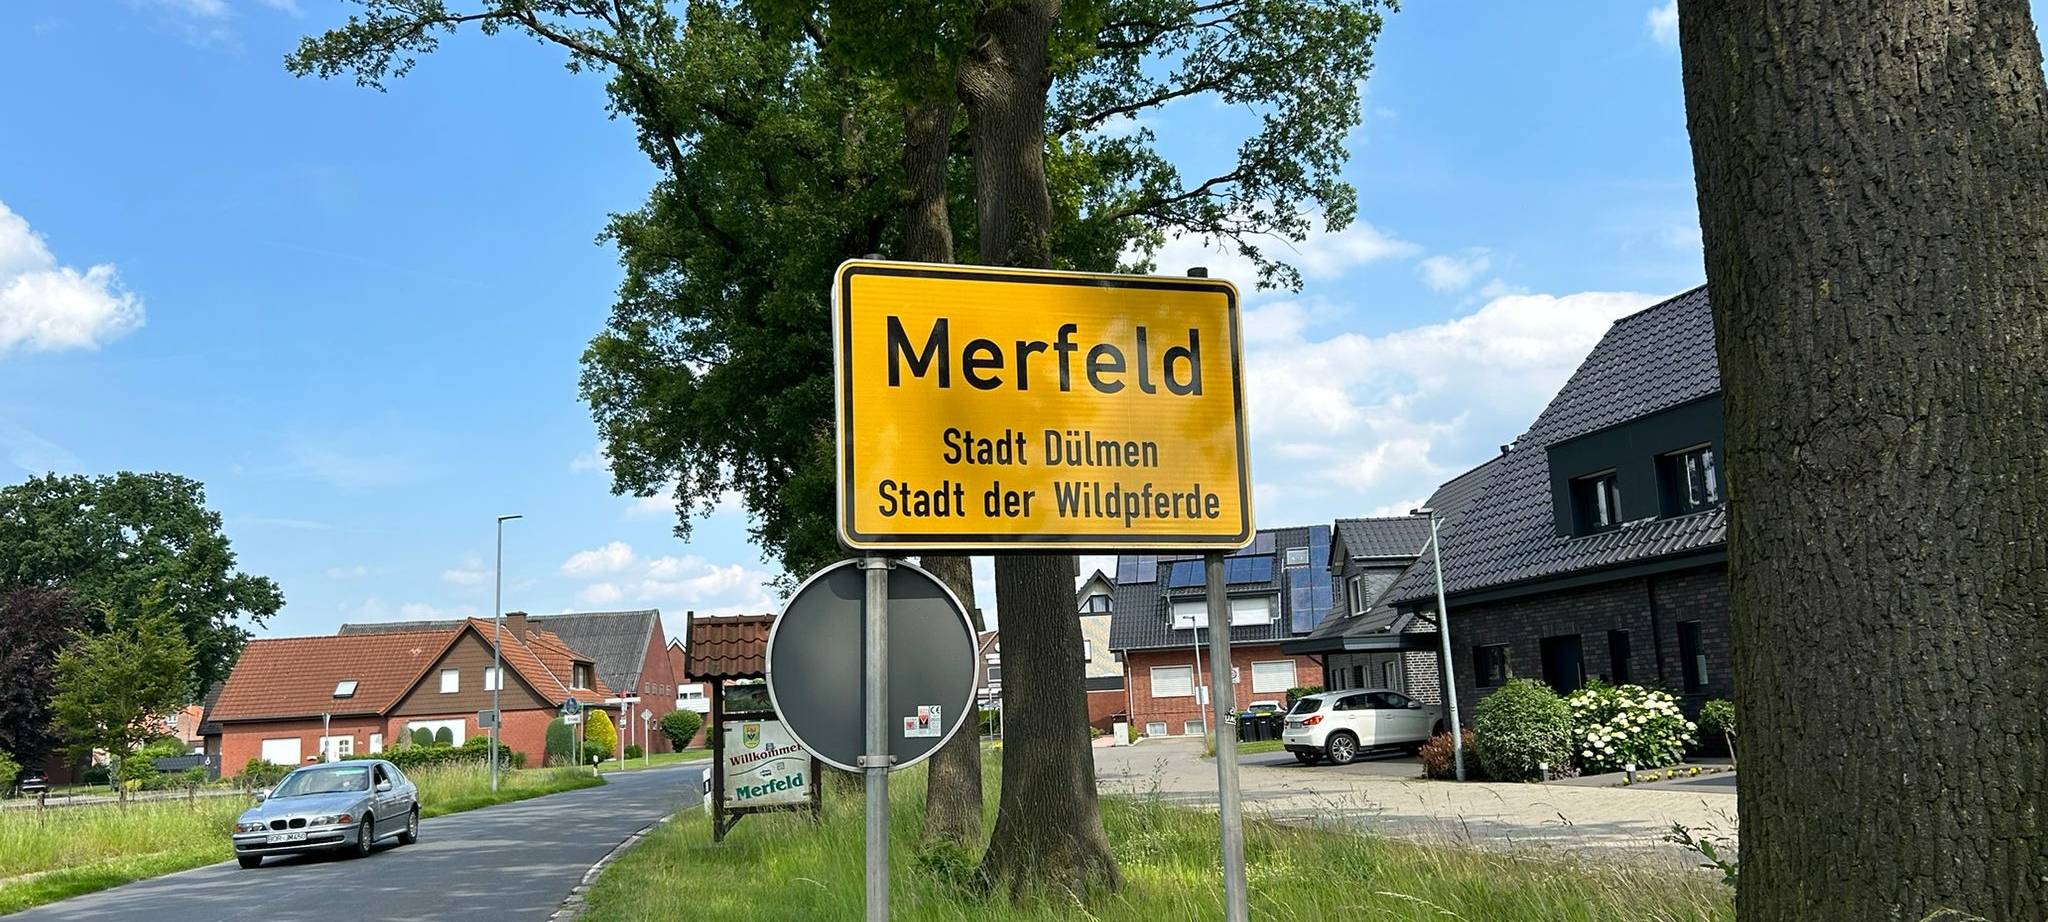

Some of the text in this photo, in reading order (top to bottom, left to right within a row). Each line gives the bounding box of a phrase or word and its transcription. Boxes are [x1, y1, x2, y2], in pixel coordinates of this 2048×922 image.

[887, 315, 1203, 396] Merfeld
[943, 427, 1159, 467] Stadt Dülmen
[878, 479, 1220, 528] Stadt der Wildpferde
[736, 772, 804, 801] Merfeld
